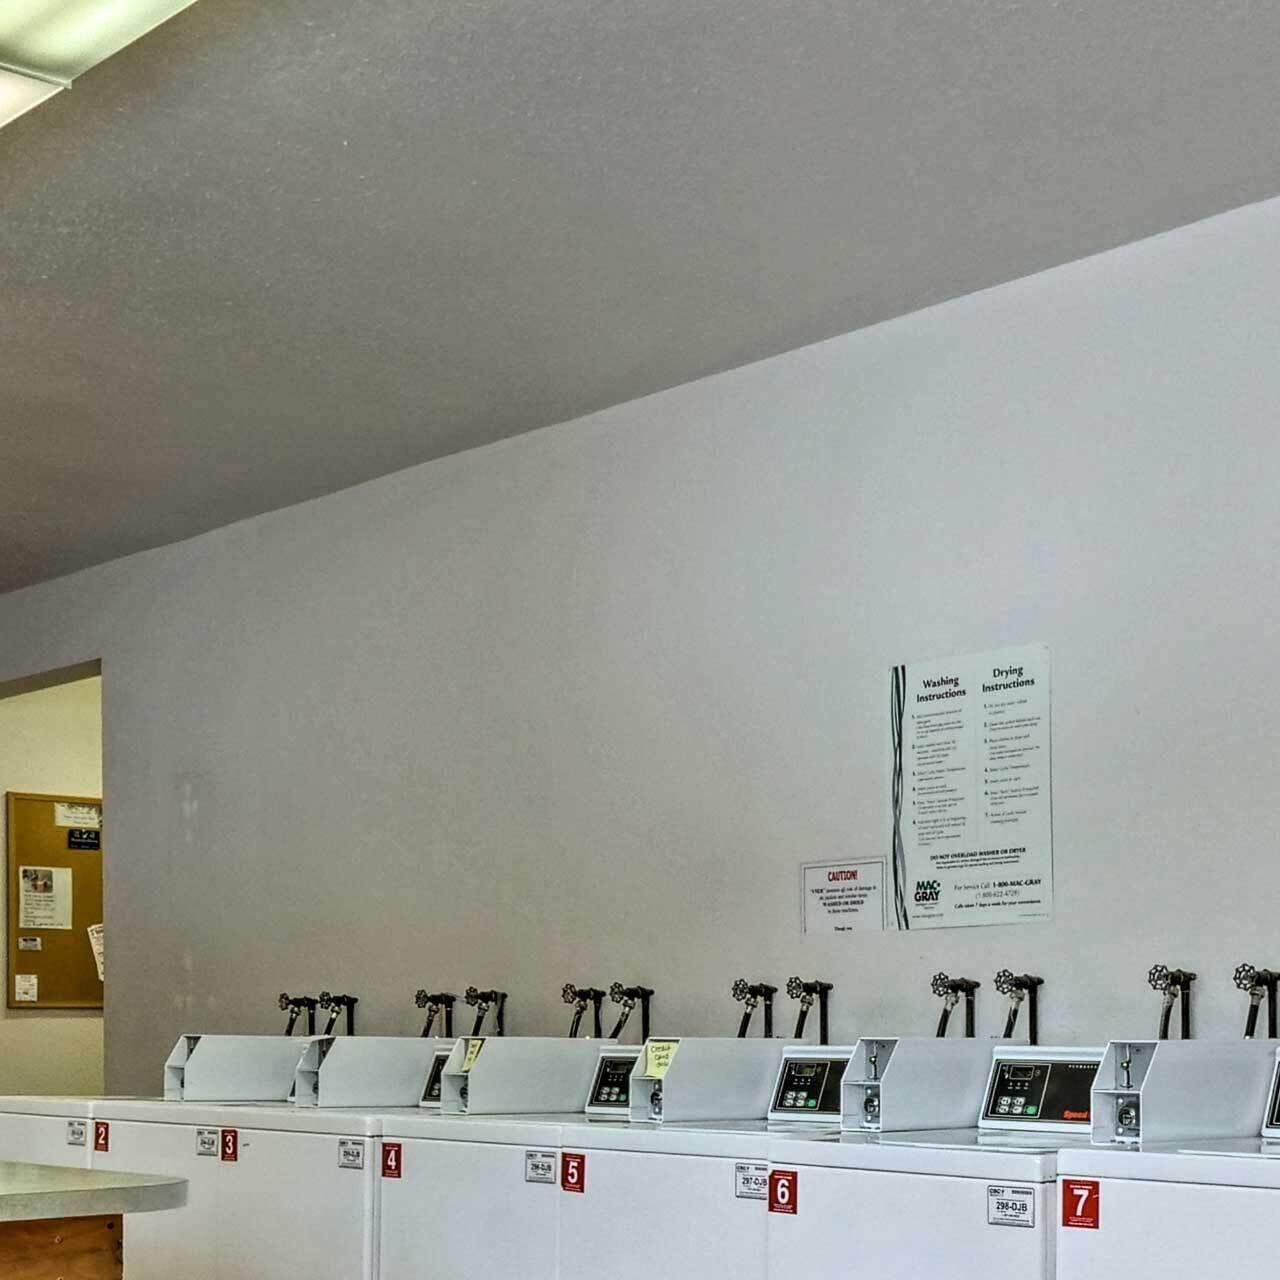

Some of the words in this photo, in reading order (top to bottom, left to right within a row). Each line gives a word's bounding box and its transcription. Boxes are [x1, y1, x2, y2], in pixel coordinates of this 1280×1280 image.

[993, 666, 1023, 678] Drying
[923, 676, 959, 688] Washing
[982, 679, 1035, 693] Instructions
[917, 689, 966, 703] Instructions
[951, 851, 977, 859] OVERLOAD
[979, 849, 999, 857] WASHER
[828, 870, 858, 881] CAUTION!
[914, 891, 940, 902] GRAY
[1063, 1110, 1089, 1120] Speed
[98, 1127, 106, 1144] 2
[225, 1135, 233, 1154] 3
[387, 1150, 397, 1170] 4
[568, 1161, 578, 1183] 5
[777, 1179, 790, 1204] 6
[996, 1201, 1028, 1212] 298-DJB
[1073, 1188, 1089, 1216] 7
